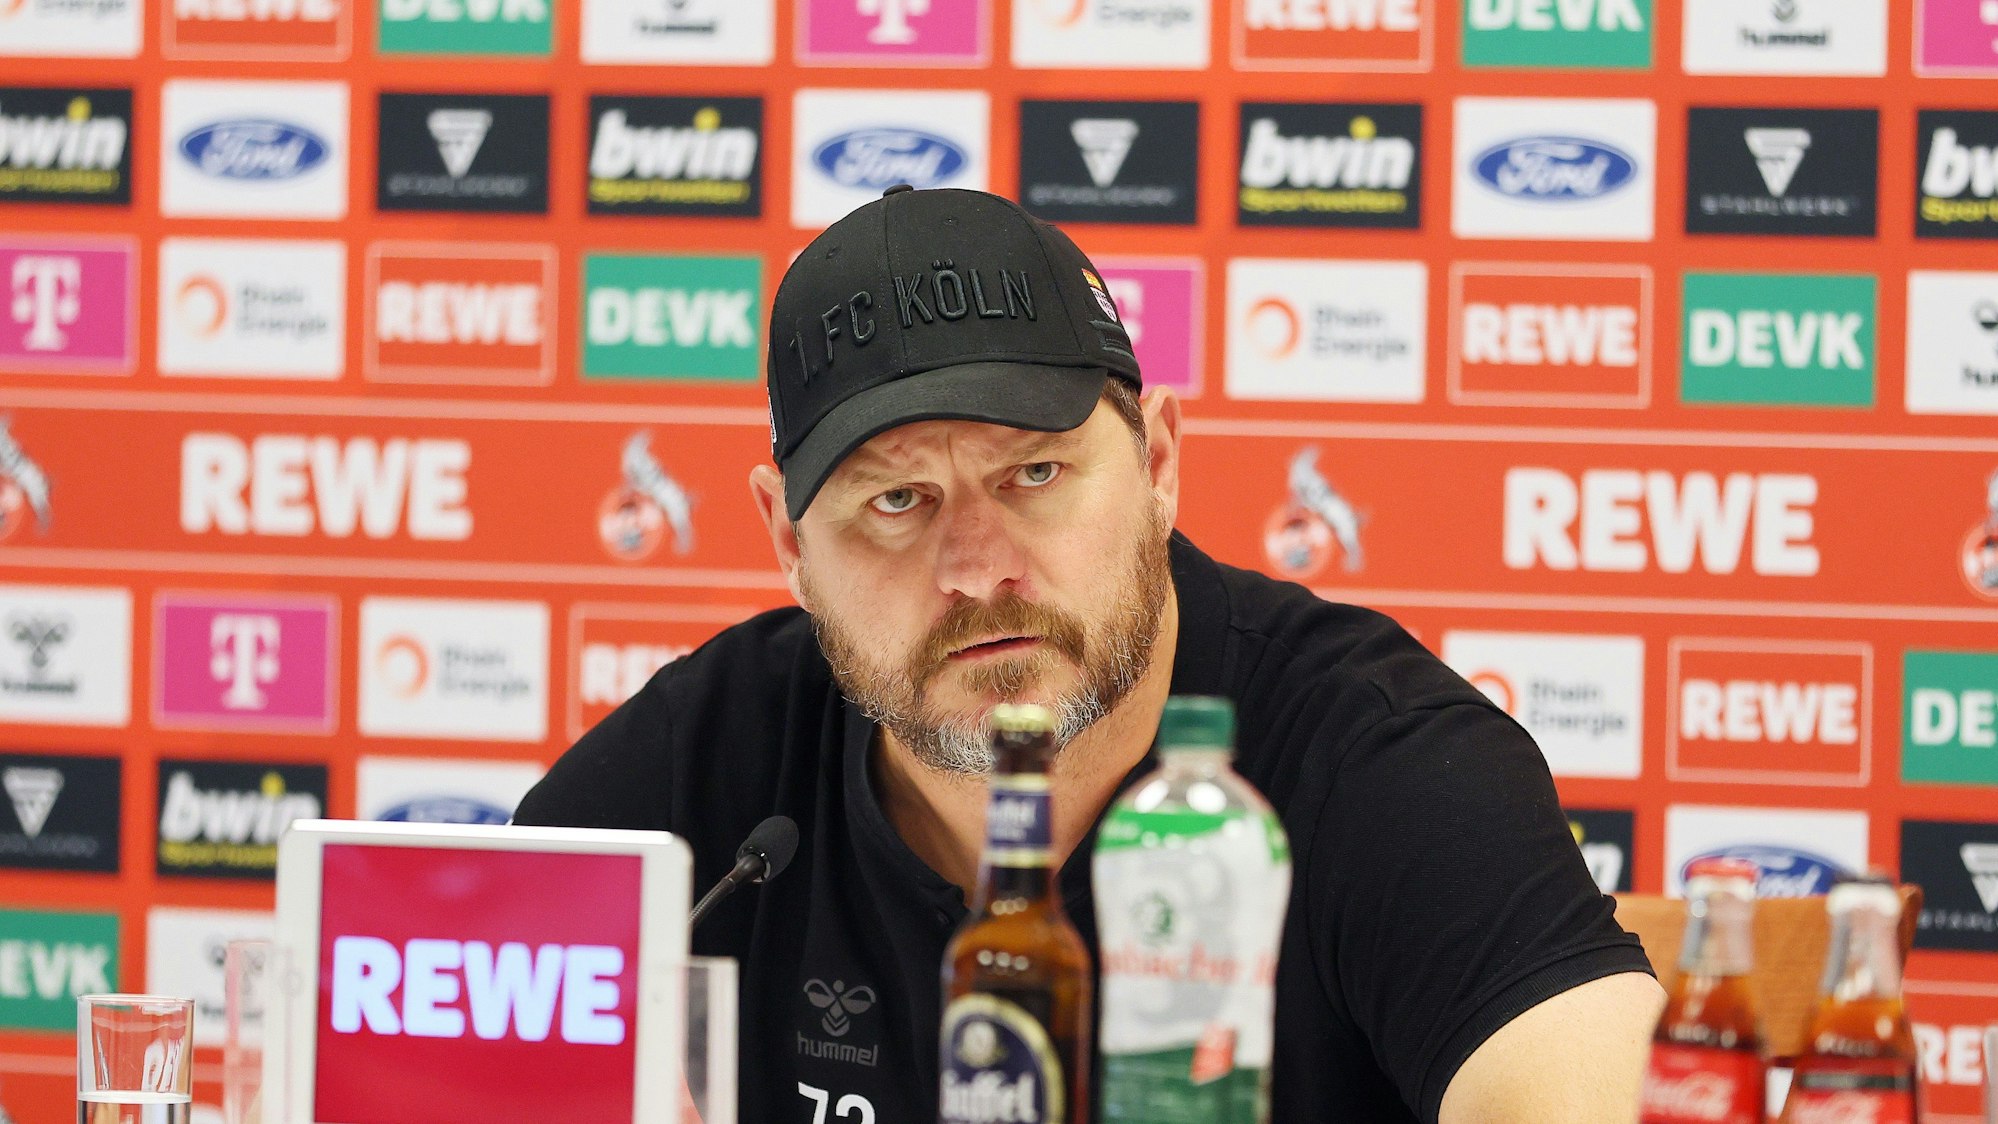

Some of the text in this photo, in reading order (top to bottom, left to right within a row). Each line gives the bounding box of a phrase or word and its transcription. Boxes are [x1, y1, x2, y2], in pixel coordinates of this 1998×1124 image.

[0, 98, 127, 170] win
[590, 108, 758, 180] bwin
[1240, 117, 1415, 188] bwin
[376, 281, 546, 345] REWE
[587, 287, 753, 347] DEVK
[821, 291, 876, 363] FC
[895, 258, 1038, 328] KÖLN
[1460, 303, 1638, 366] REWE
[1689, 309, 1864, 369] DEVK
[180, 432, 473, 540] REWE
[1503, 467, 1820, 576] REWE
[210, 614, 280, 709] T
[582, 643, 688, 705] RE
[1681, 679, 1857, 743] REWE
[331, 935, 625, 1045] REWE
[797, 1030, 879, 1067] hummel
[1911, 1022, 1990, 1085] RE
